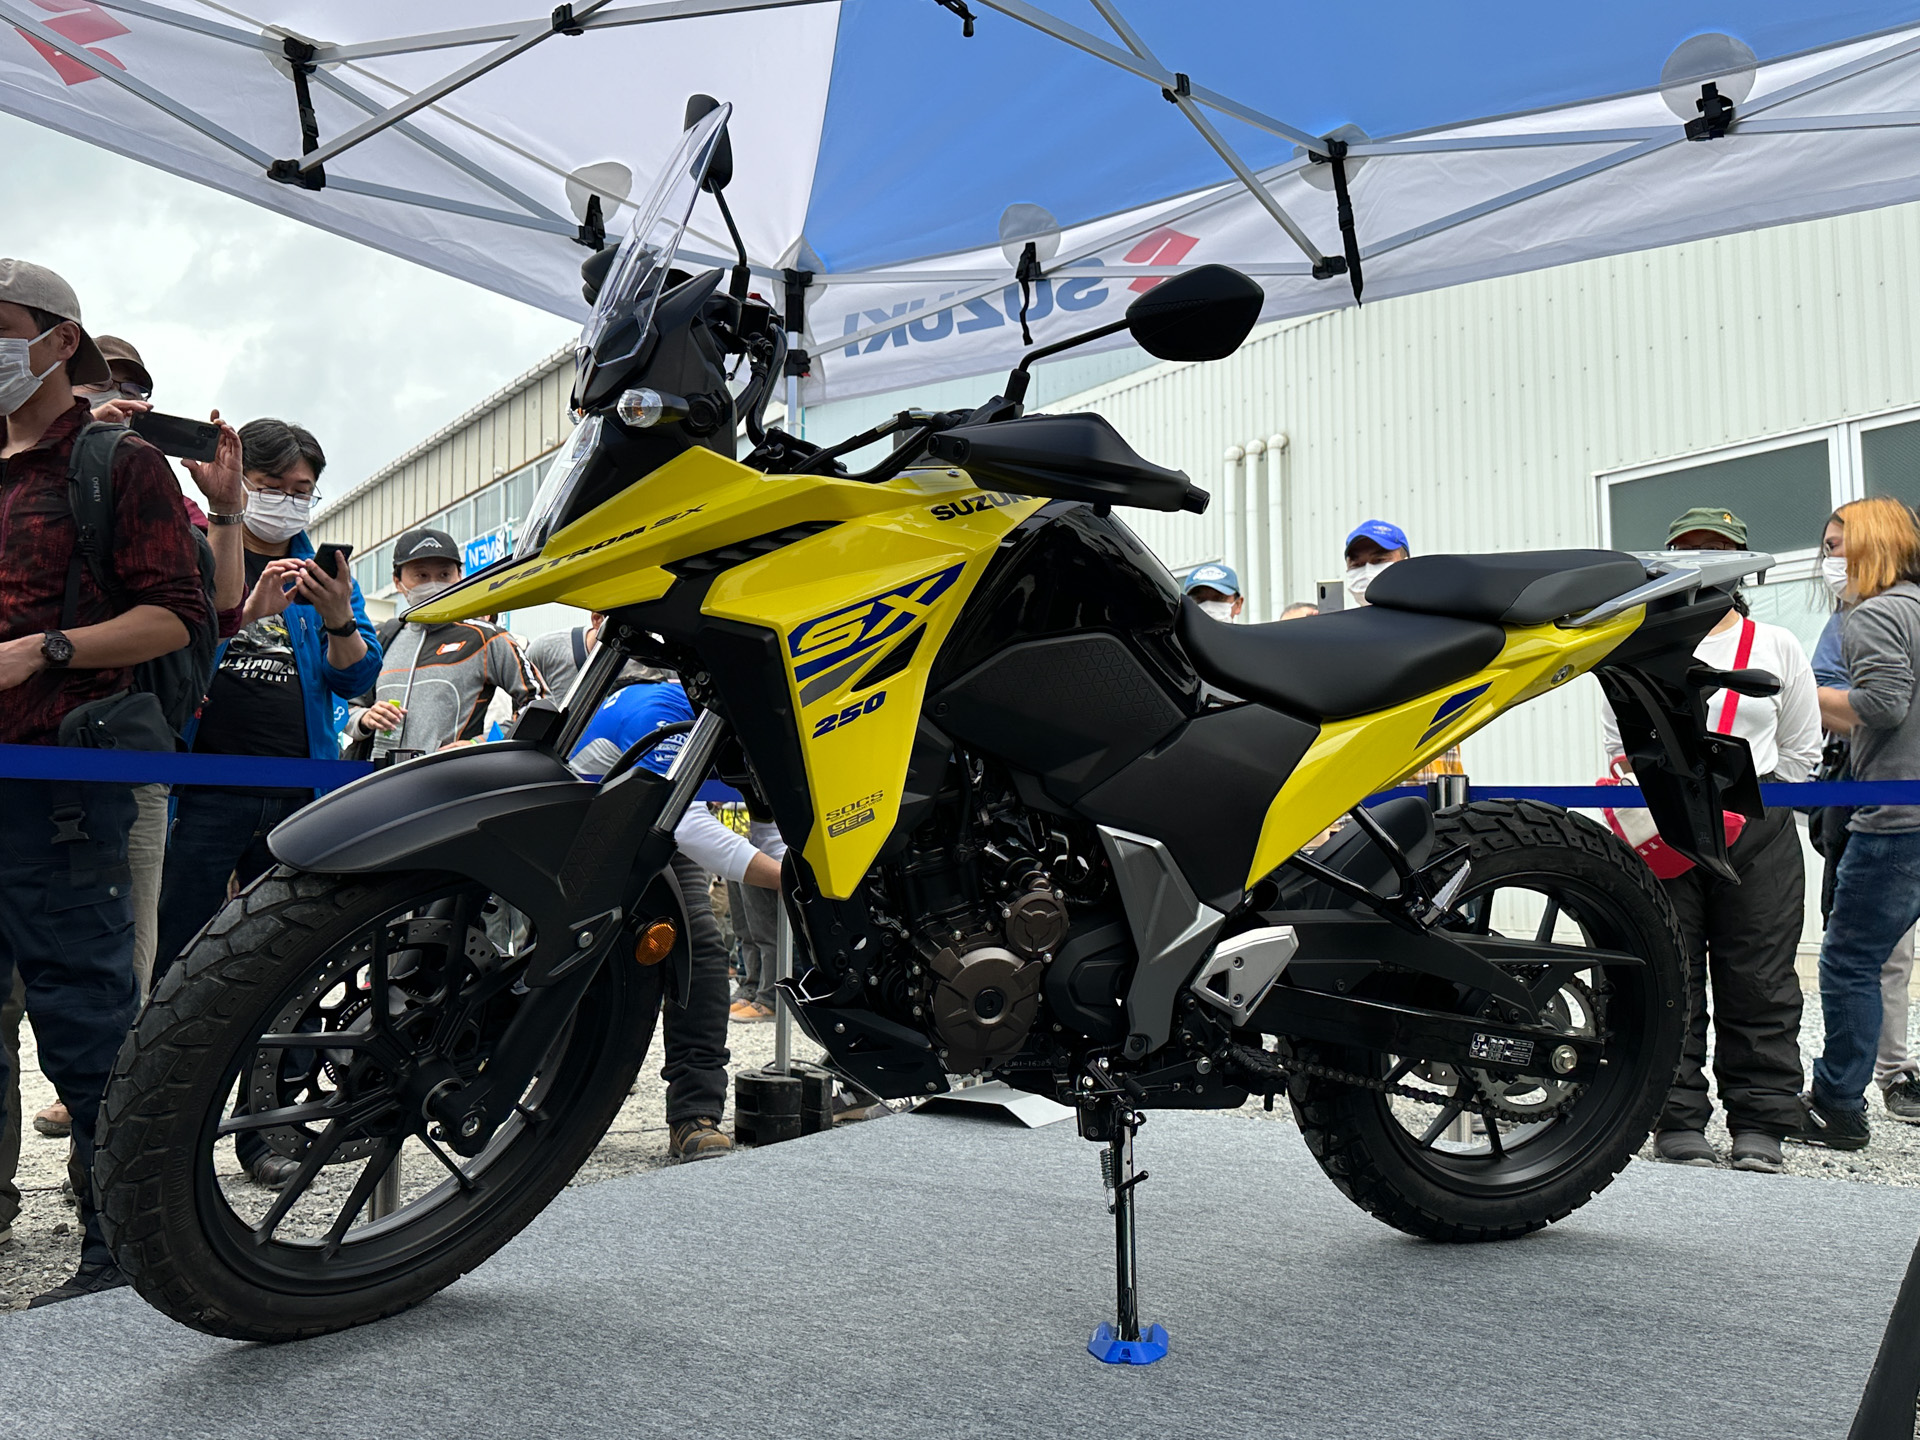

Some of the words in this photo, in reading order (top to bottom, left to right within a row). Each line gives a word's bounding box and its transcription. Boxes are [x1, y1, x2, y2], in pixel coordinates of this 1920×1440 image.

[930, 491, 1038, 521] SUZUK
[488, 525, 647, 592] V-STROM
[649, 502, 709, 531] SX
[793, 569, 952, 654] SX
[241, 670, 288, 683] SUZUKI
[811, 690, 887, 740] 250
[825, 789, 884, 821] SOCS
[831, 810, 871, 833] SEP
